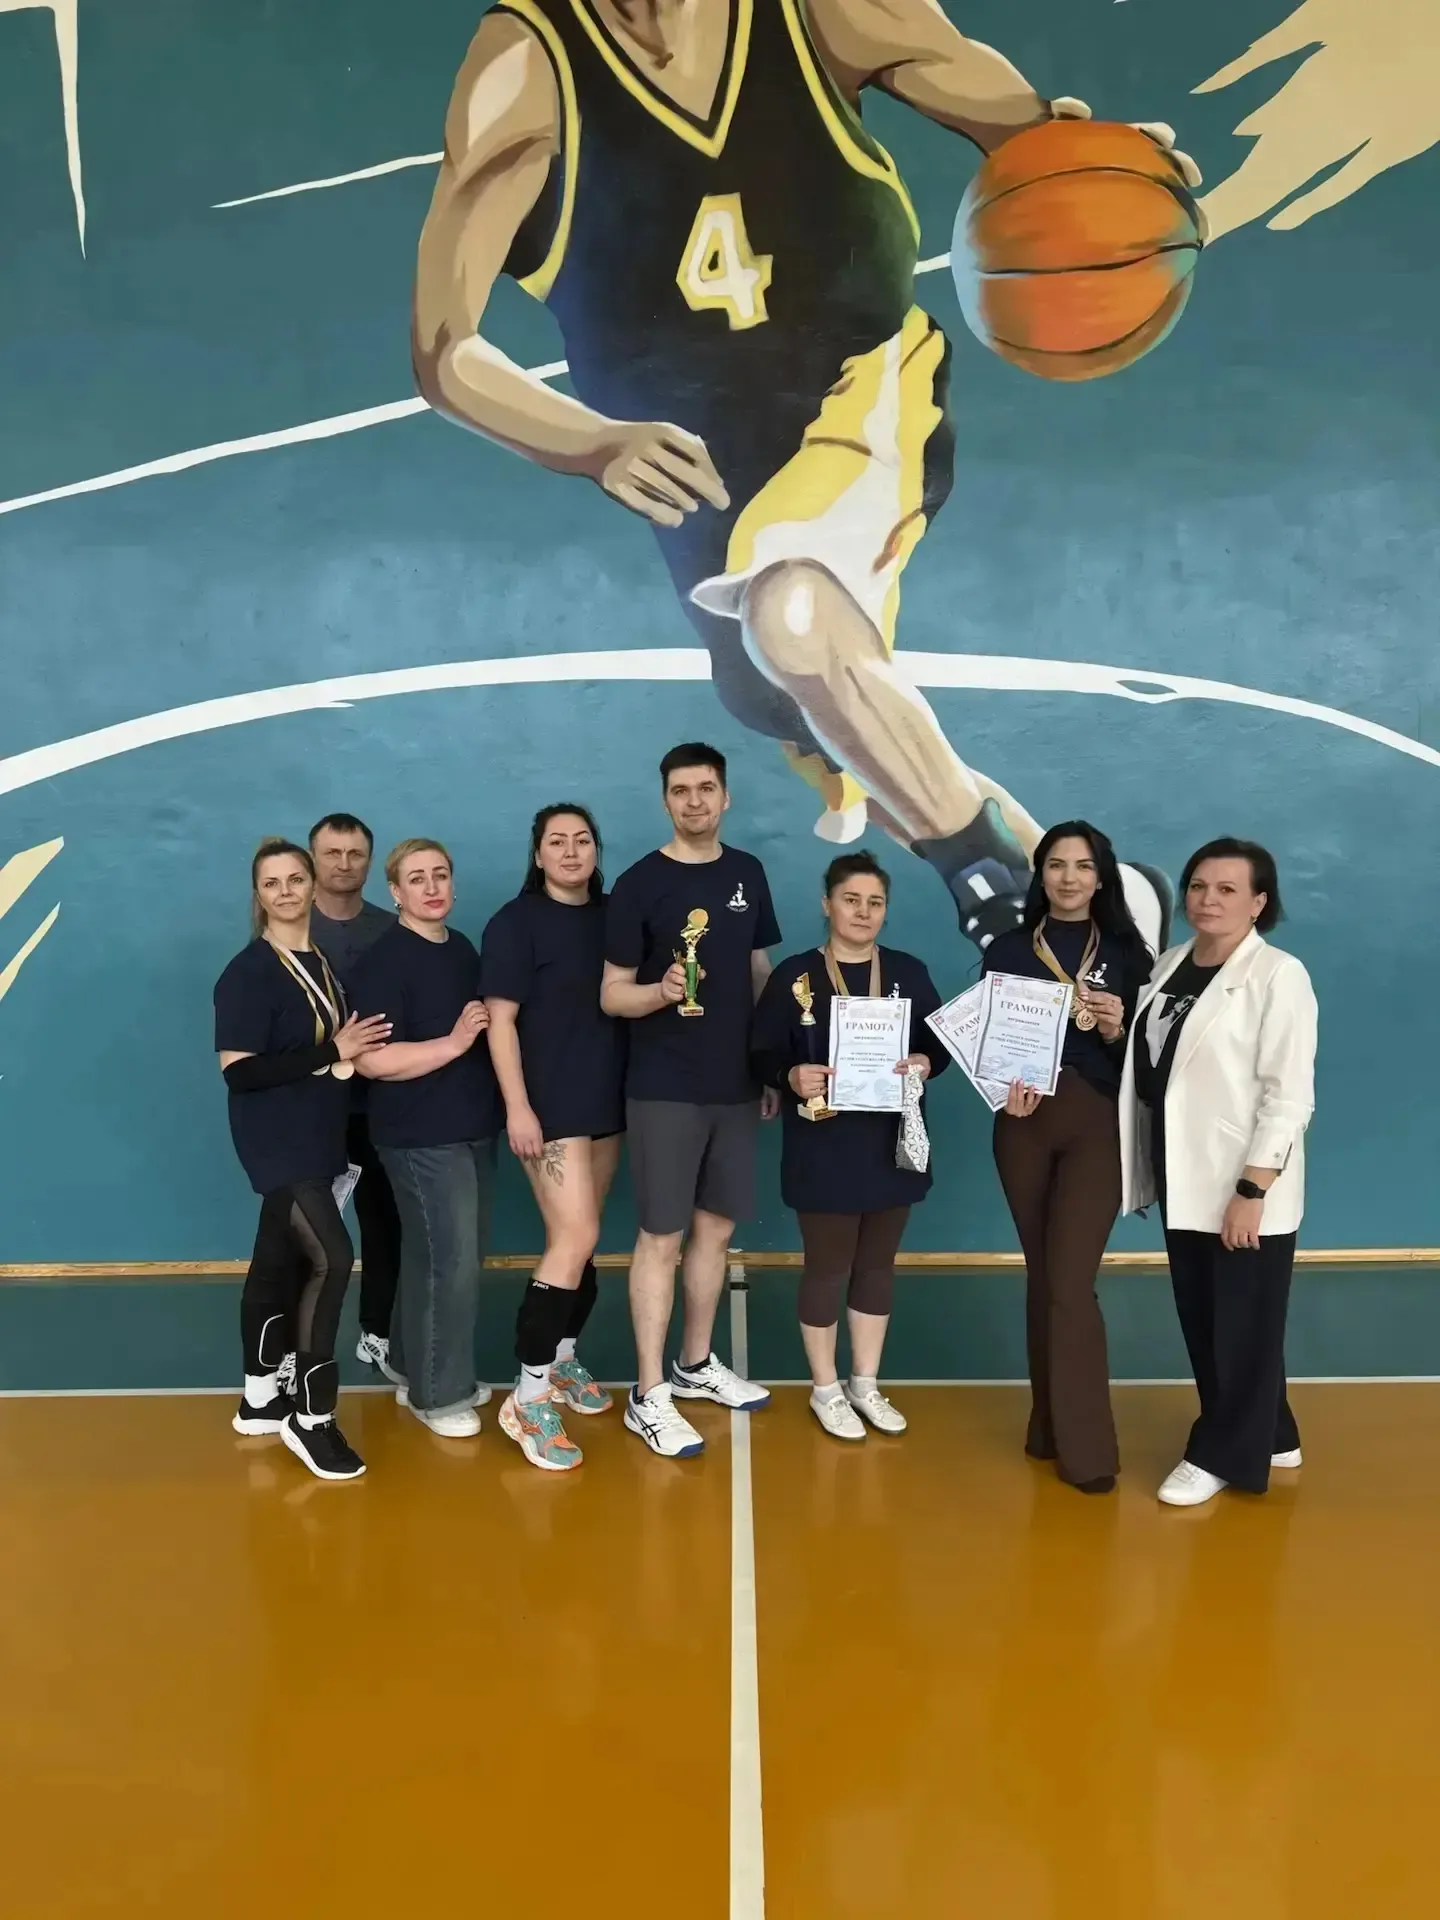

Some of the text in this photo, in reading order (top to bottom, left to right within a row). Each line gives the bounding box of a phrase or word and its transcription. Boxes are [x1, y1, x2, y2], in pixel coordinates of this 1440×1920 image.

[676, 192, 773, 331] 4
[1000, 1000, 1053, 1018] ГРАМОТА
[846, 1022, 894, 1032] ГРАМОТА
